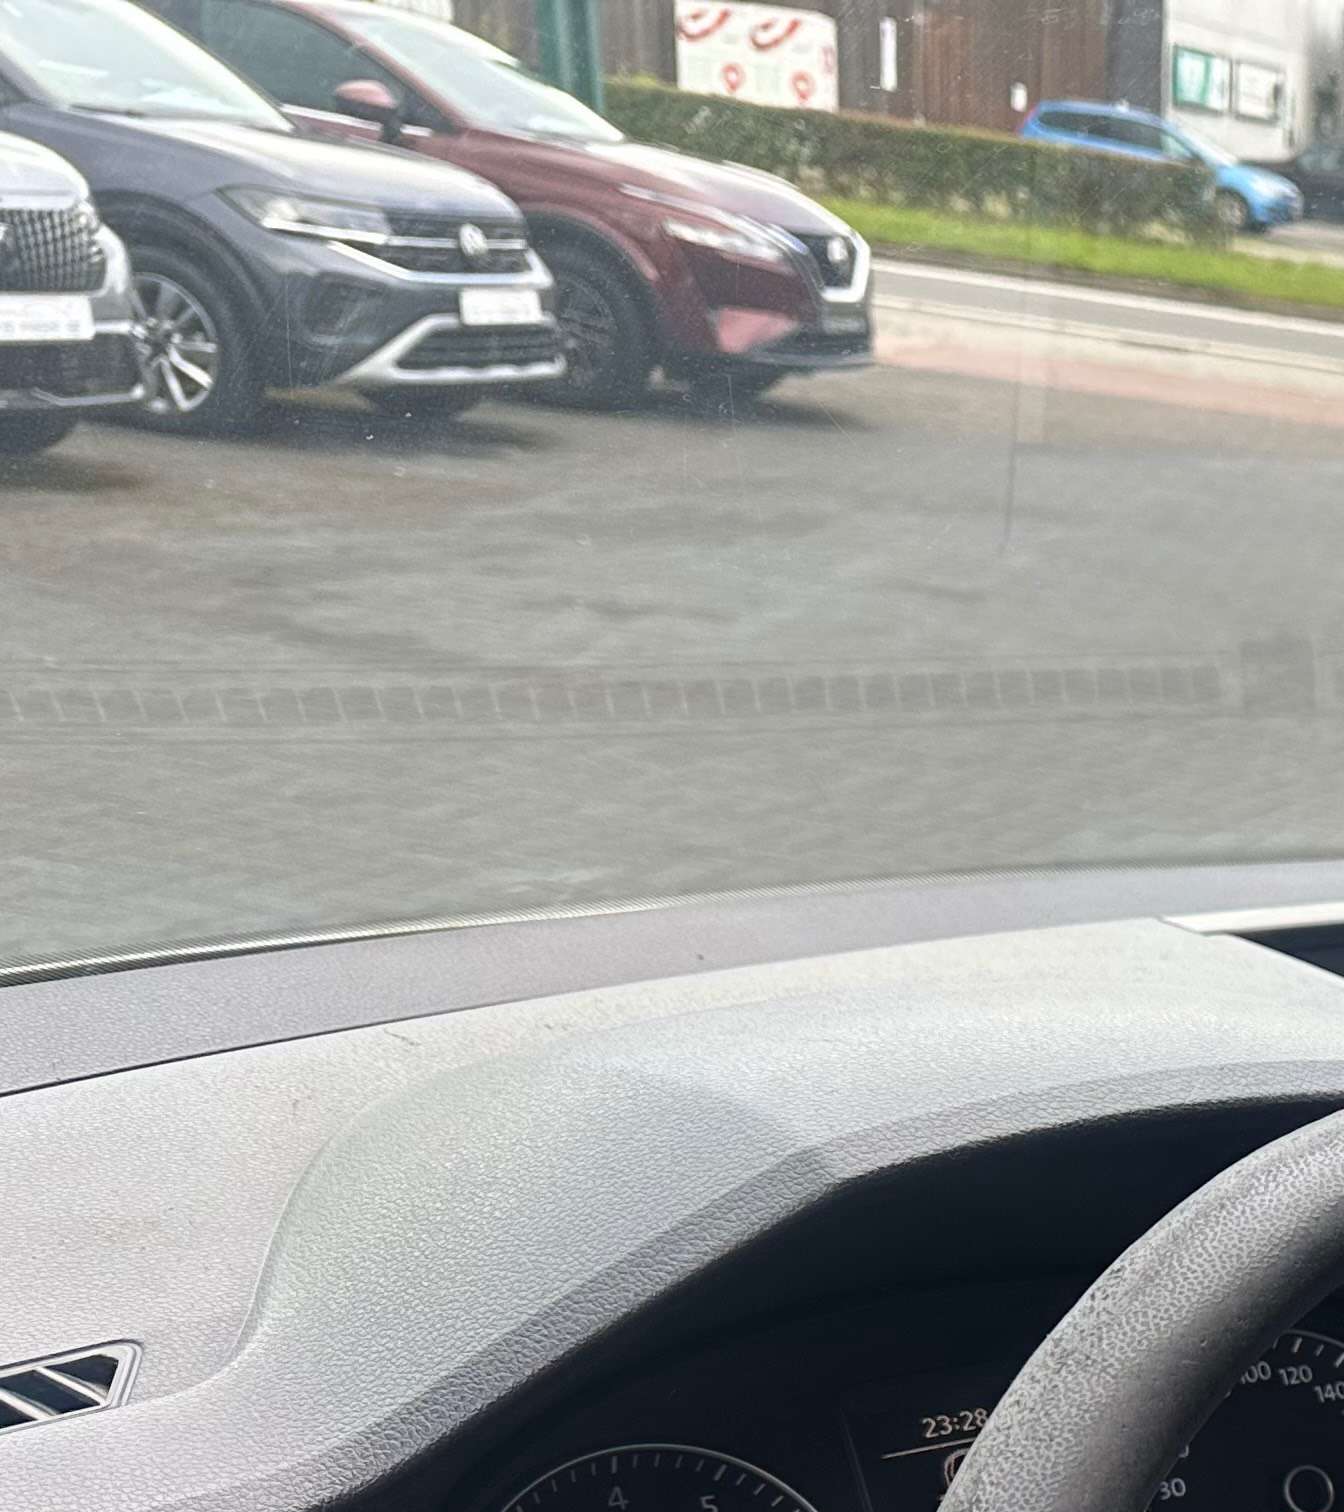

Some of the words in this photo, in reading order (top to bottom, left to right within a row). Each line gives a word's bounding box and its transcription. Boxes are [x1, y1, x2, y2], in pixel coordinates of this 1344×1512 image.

[1279, 1365, 1313, 1386] 120
[922, 1408, 988, 1439] 23:28
[607, 1485, 629, 1511] 4
